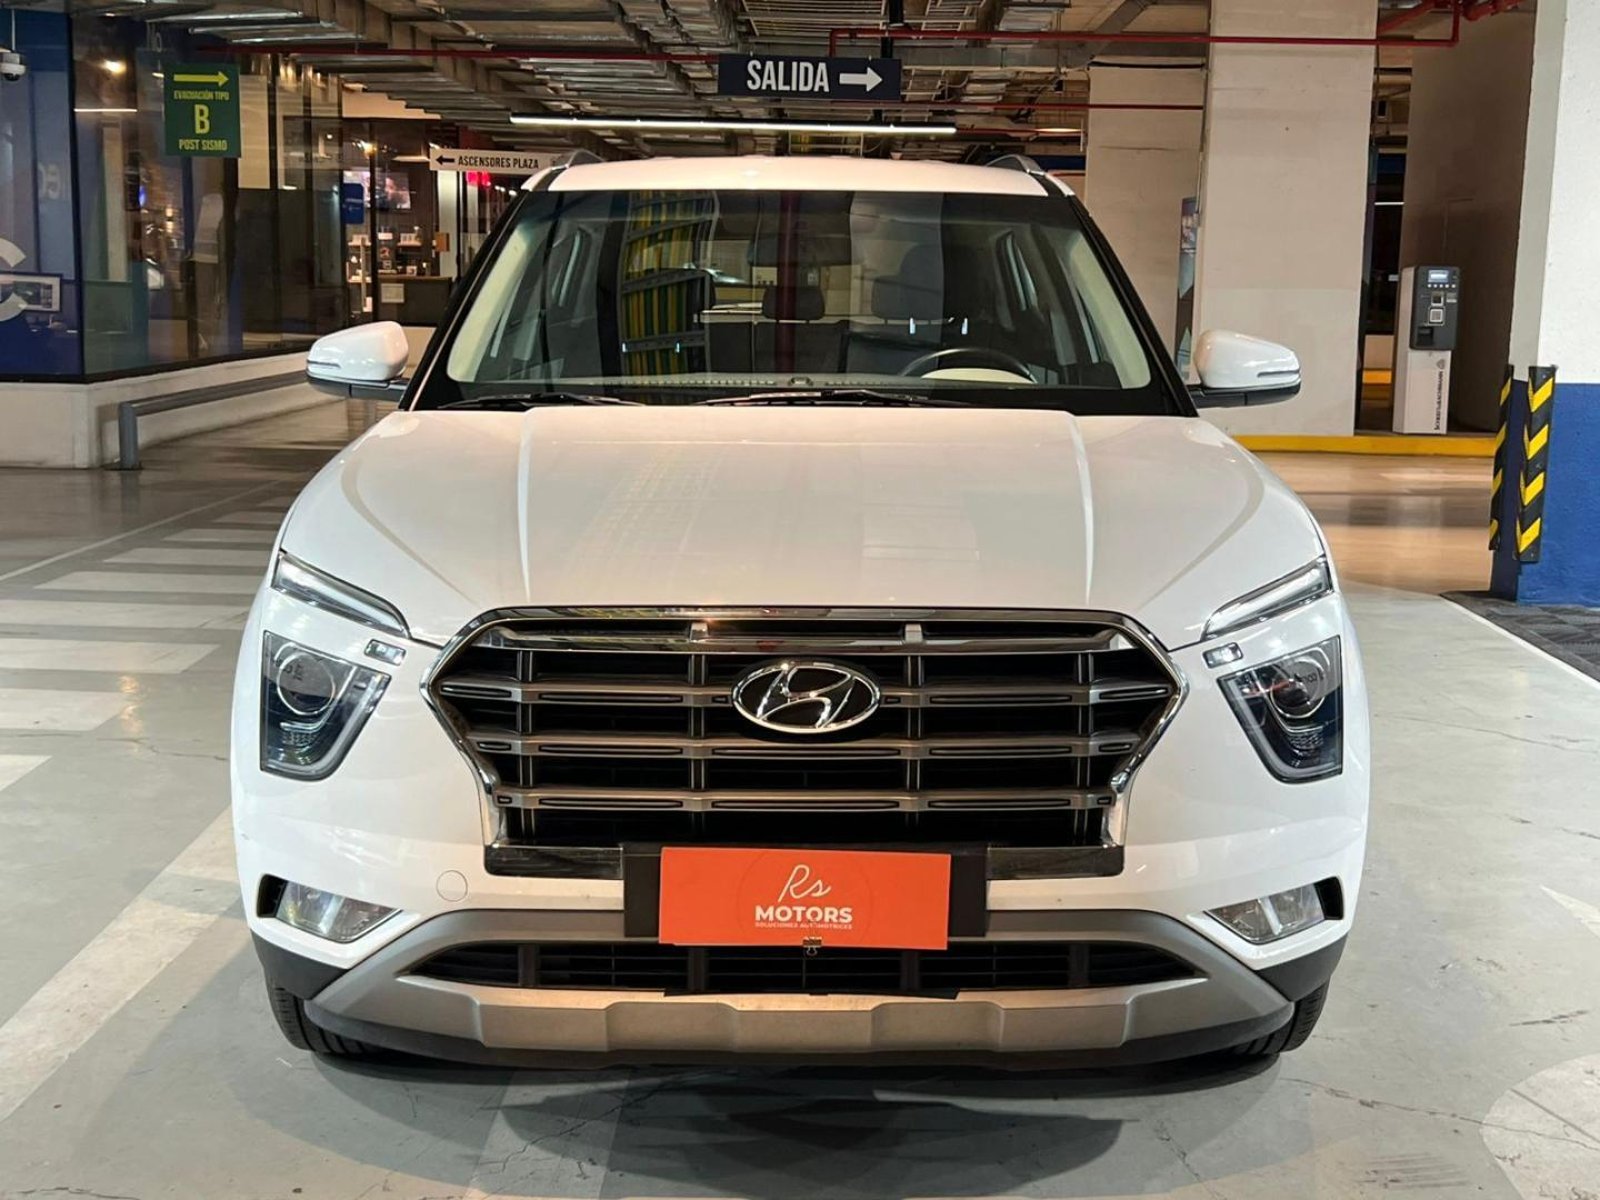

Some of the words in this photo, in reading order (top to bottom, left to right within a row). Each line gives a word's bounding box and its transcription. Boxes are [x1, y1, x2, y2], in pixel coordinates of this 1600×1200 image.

[746, 59, 830, 93] SALIDA
[214, 91, 230, 100] TIPO
[194, 104, 210, 134] B
[178, 139, 200, 150] POST
[201, 140, 228, 151] SISMO
[458, 156, 511, 168] ASCENSORES
[512, 158, 539, 169] PLAZA
[778, 864, 832, 903] Rs
[754, 905, 853, 923] MOTORS
